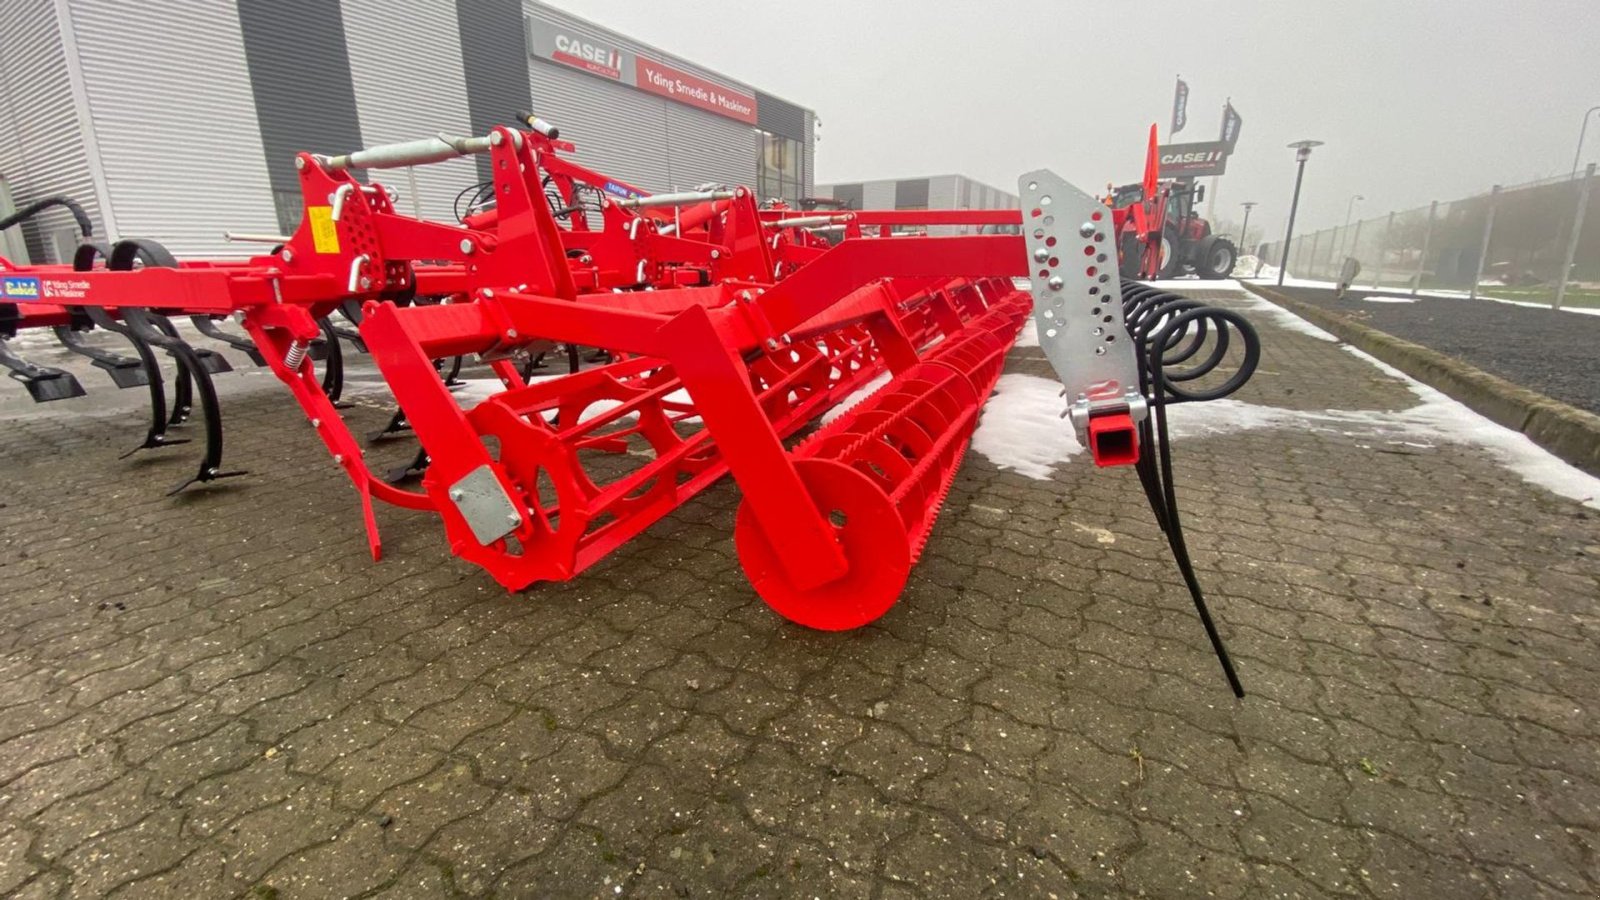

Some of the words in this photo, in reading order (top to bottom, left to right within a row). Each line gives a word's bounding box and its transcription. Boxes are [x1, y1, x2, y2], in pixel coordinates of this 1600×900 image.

[555, 35, 606, 65] CASE
[645, 68, 675, 94] Yding
[675, 79, 708, 102] Smedie
[709, 91, 717, 105] &
[718, 94, 751, 116] Maskiner
[1161, 152, 1206, 165] CASE
